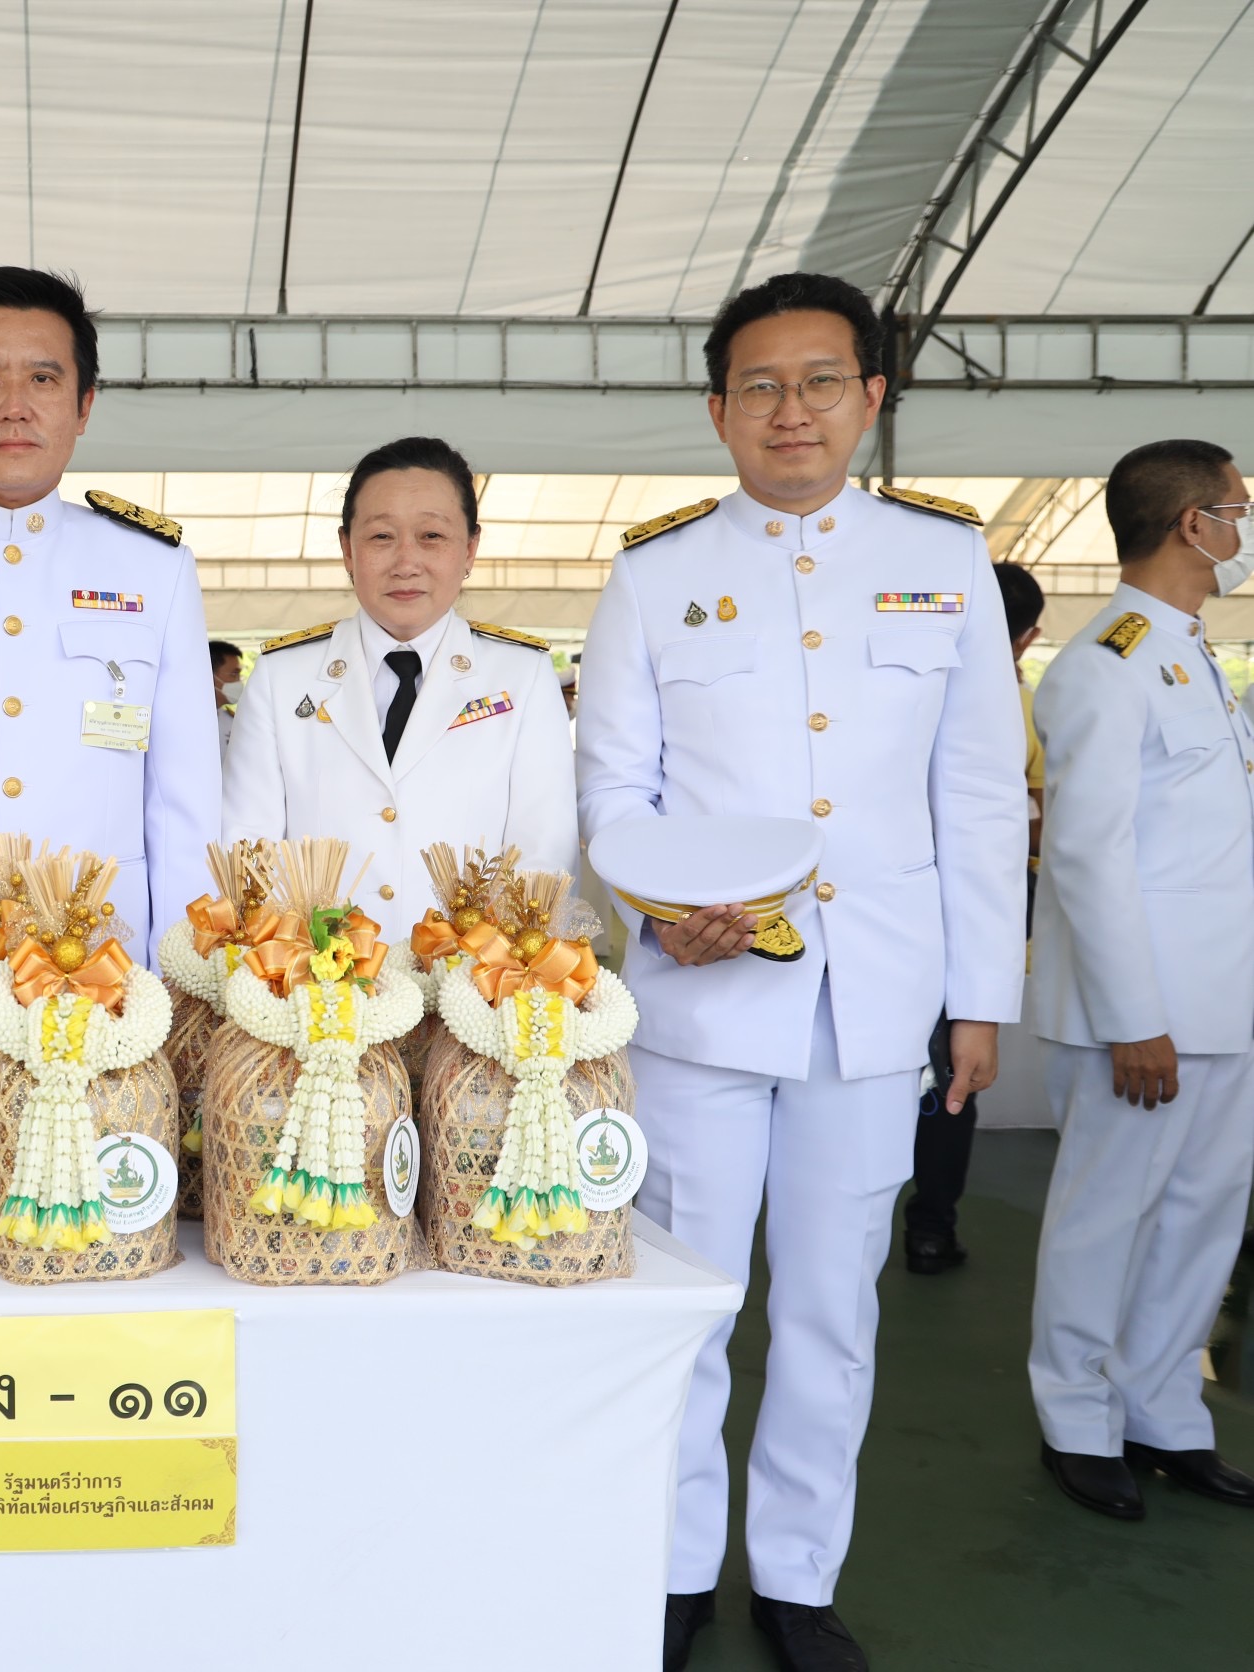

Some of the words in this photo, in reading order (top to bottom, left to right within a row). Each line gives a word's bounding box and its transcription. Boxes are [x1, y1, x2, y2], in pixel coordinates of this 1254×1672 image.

[49, 1394, 75, 1402] -
[108, 1379, 207, 1420] ๑๑
[3, 1472, 122, 1494] รัฐมนตรีว่าการ
